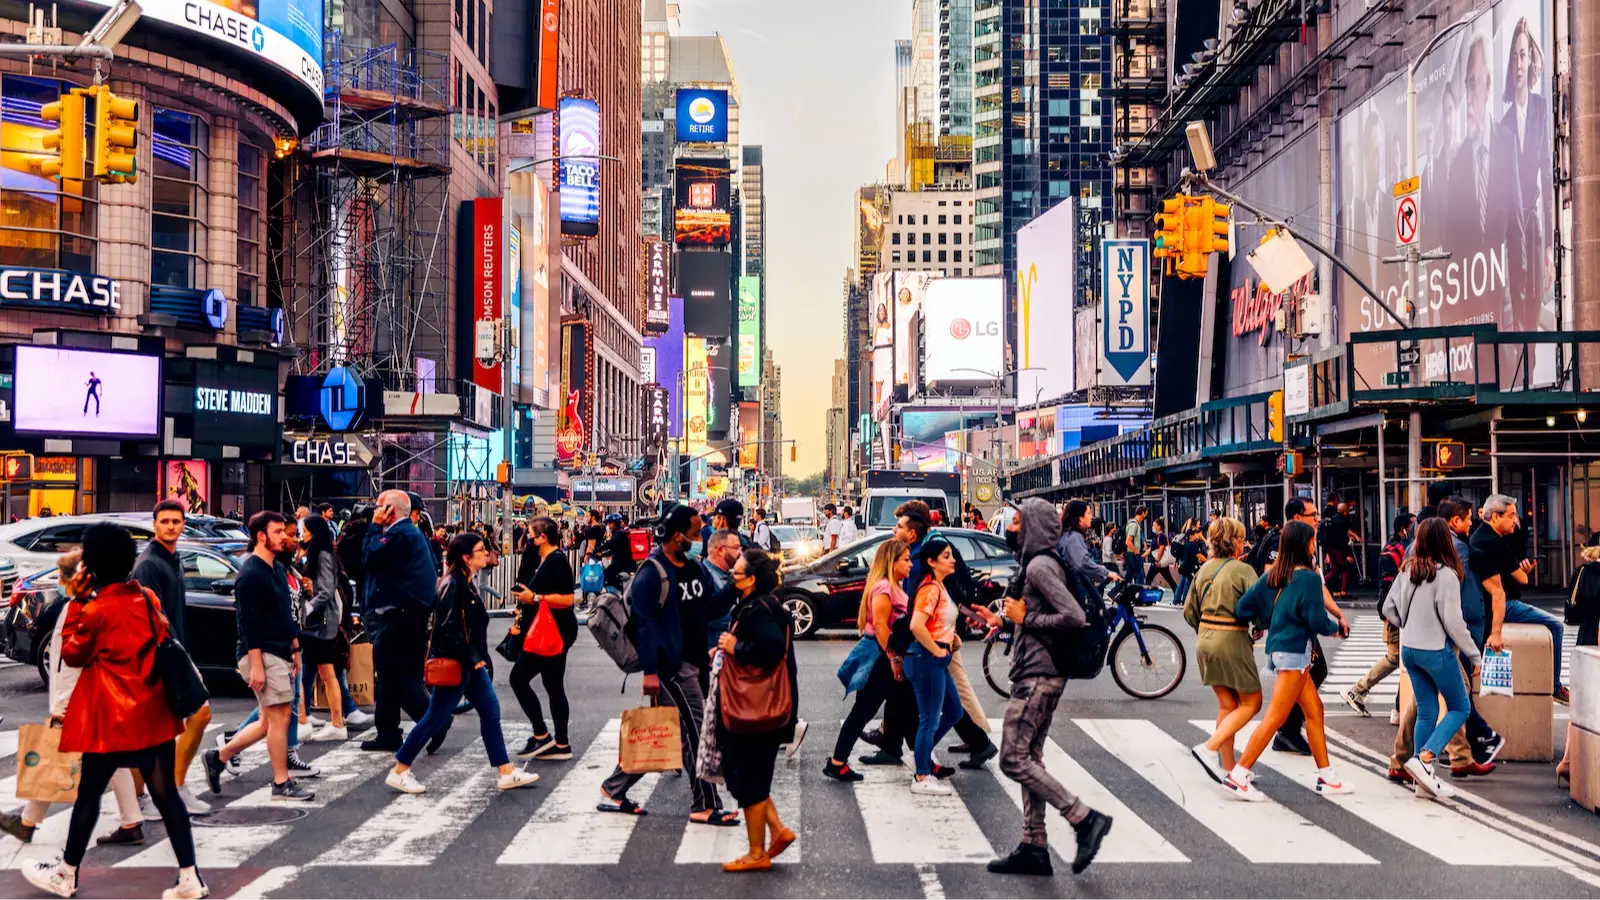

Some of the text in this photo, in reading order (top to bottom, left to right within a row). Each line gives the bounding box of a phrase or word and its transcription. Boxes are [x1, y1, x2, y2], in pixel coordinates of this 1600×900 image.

[185, 2, 248, 44] CHASE
[689, 124, 714, 133] RETIRE
[565, 164, 595, 177] TACO
[567, 175, 596, 187] BELL
[1401, 180, 1413, 191] NEW
[483, 223, 494, 278] REUTERS
[0, 270, 121, 309] CHASE
[1117, 247, 1134, 351] NYPD
[975, 321, 999, 337] LG
[196, 387, 272, 415] STEVE MADDEN
[293, 440, 357, 464] CHASE
[972, 468, 986, 476] U.S.
[678, 579, 704, 600] XO
[360, 683, 368, 692] 21
